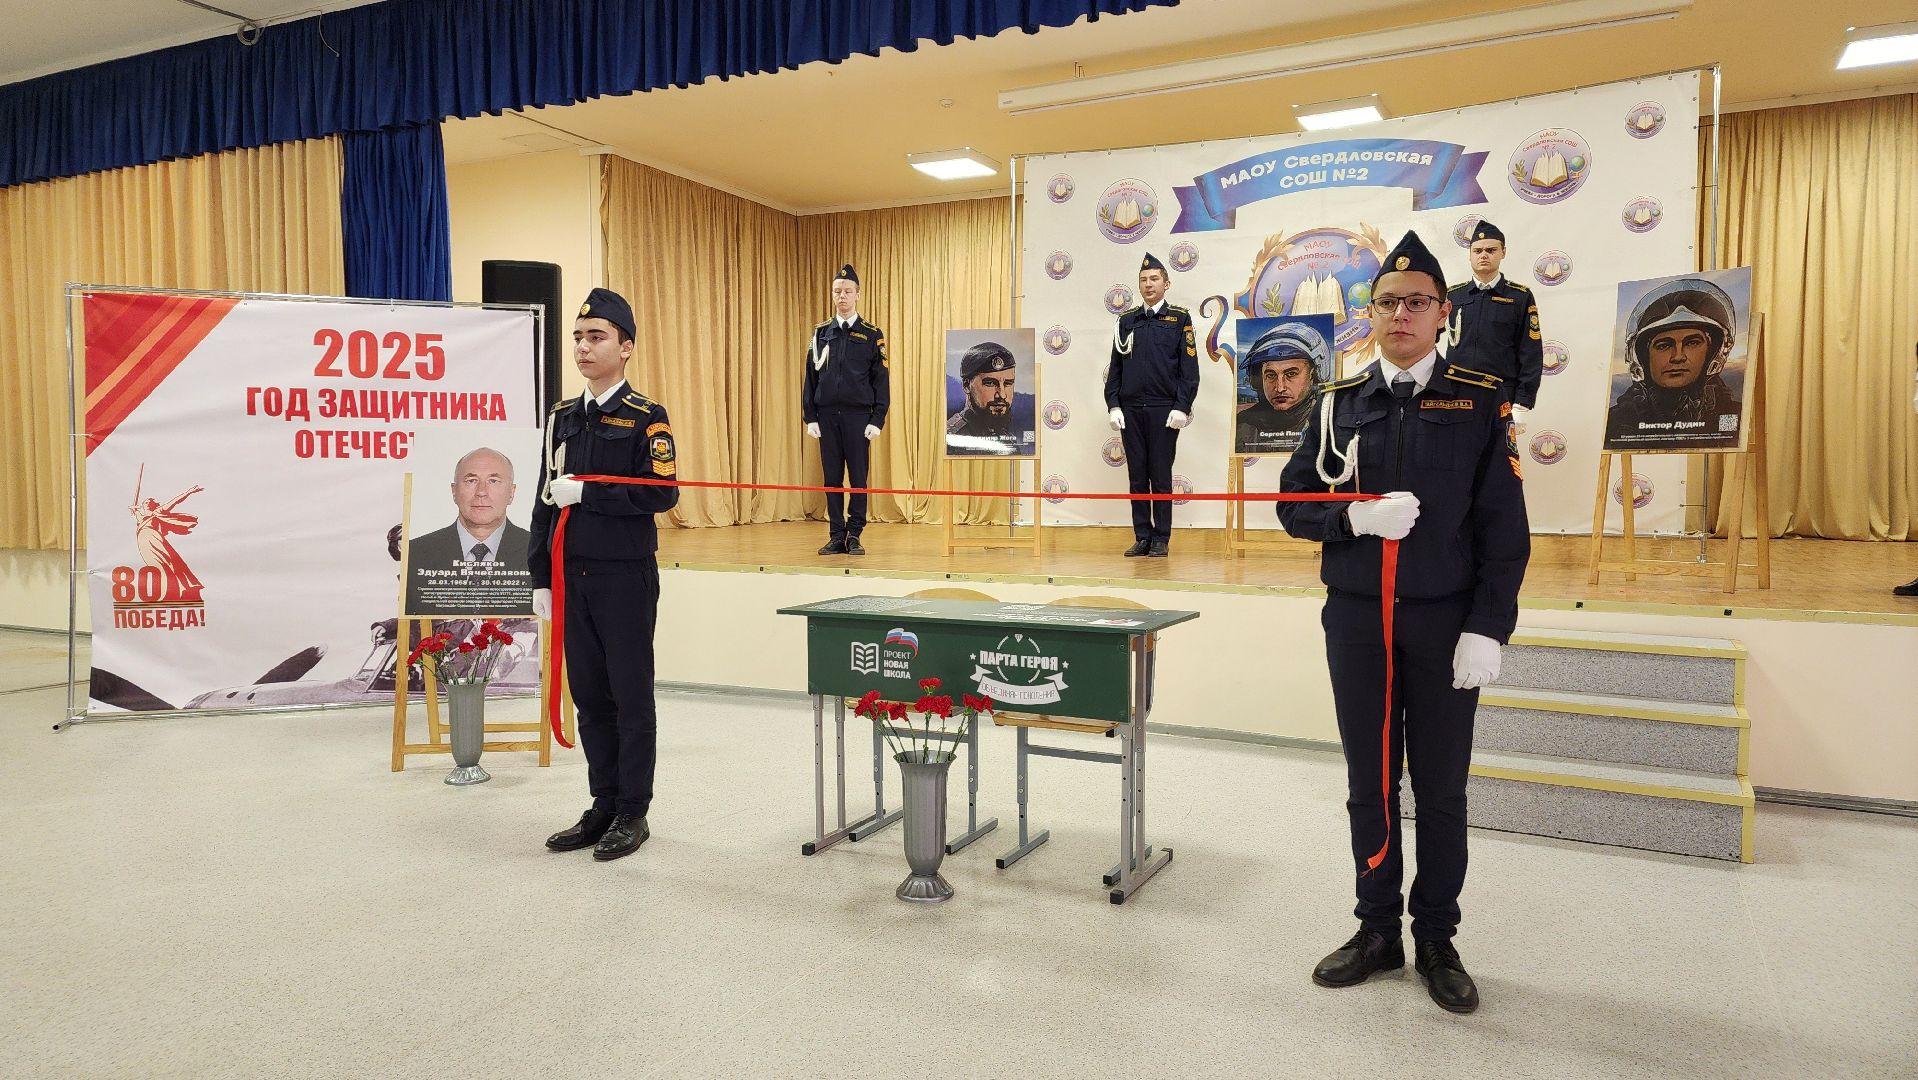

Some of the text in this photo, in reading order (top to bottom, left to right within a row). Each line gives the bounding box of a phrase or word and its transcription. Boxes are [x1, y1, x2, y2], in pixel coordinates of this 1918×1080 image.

[1220, 150, 1434, 189] МАОУ Свердловская
[1279, 167, 1369, 189] СОШ №2
[1303, 239, 1334, 252] МАОУ
[1277, 252, 1340, 271] Свердловская
[313, 328, 446, 381] 2025
[246, 386, 507, 423] ГОД ЗАЩИТНИКА
[1259, 430, 1284, 438] Сергей
[1638, 421, 1705, 430] Виктор Дудин
[294, 429, 414, 459] ОТЕЧЕС
[417, 568, 458, 577] Эдуард
[111, 565, 161, 603] 80
[113, 609, 205, 631] ПОБЕДА!
[883, 650, 911, 660] ПРОЕКТ
[883, 660, 909, 670] НОВАЯ
[980, 650, 1058, 671] ПАРТА ГЕРОЯ
[883, 669, 911, 680] ШКОЛА
